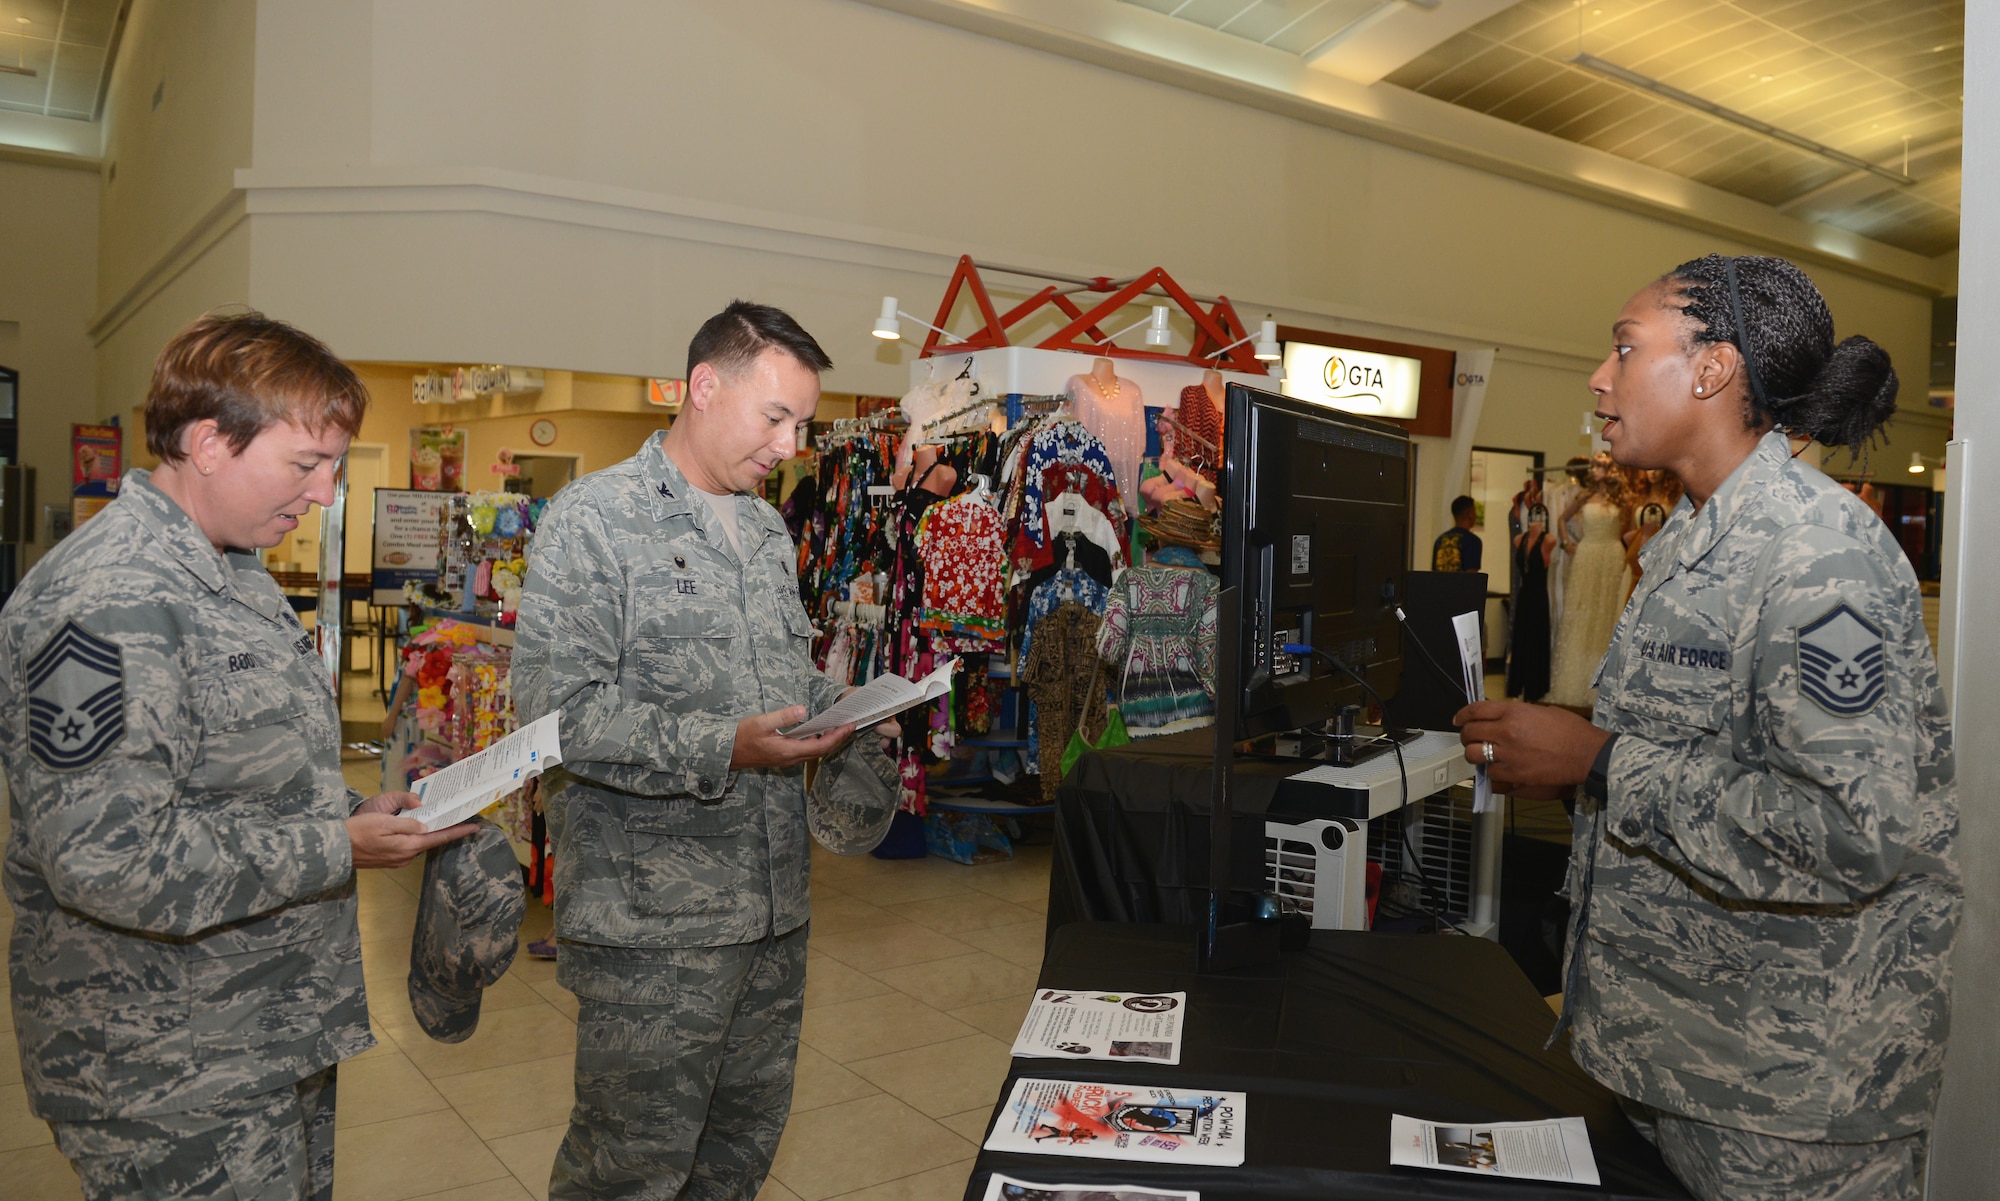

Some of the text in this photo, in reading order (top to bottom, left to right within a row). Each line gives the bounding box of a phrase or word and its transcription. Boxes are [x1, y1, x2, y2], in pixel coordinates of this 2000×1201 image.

[1349, 366, 1384, 389] GTA
[1466, 373, 1484, 384] GTA
[676, 578, 699, 596] LEE
[1641, 640, 1727, 671] U.S. AIR FORCE
[1081, 1089, 1105, 1111] RUCK
[1218, 1106, 1234, 1140] POW-MIA
[1198, 1133, 1211, 1146] WEEK
